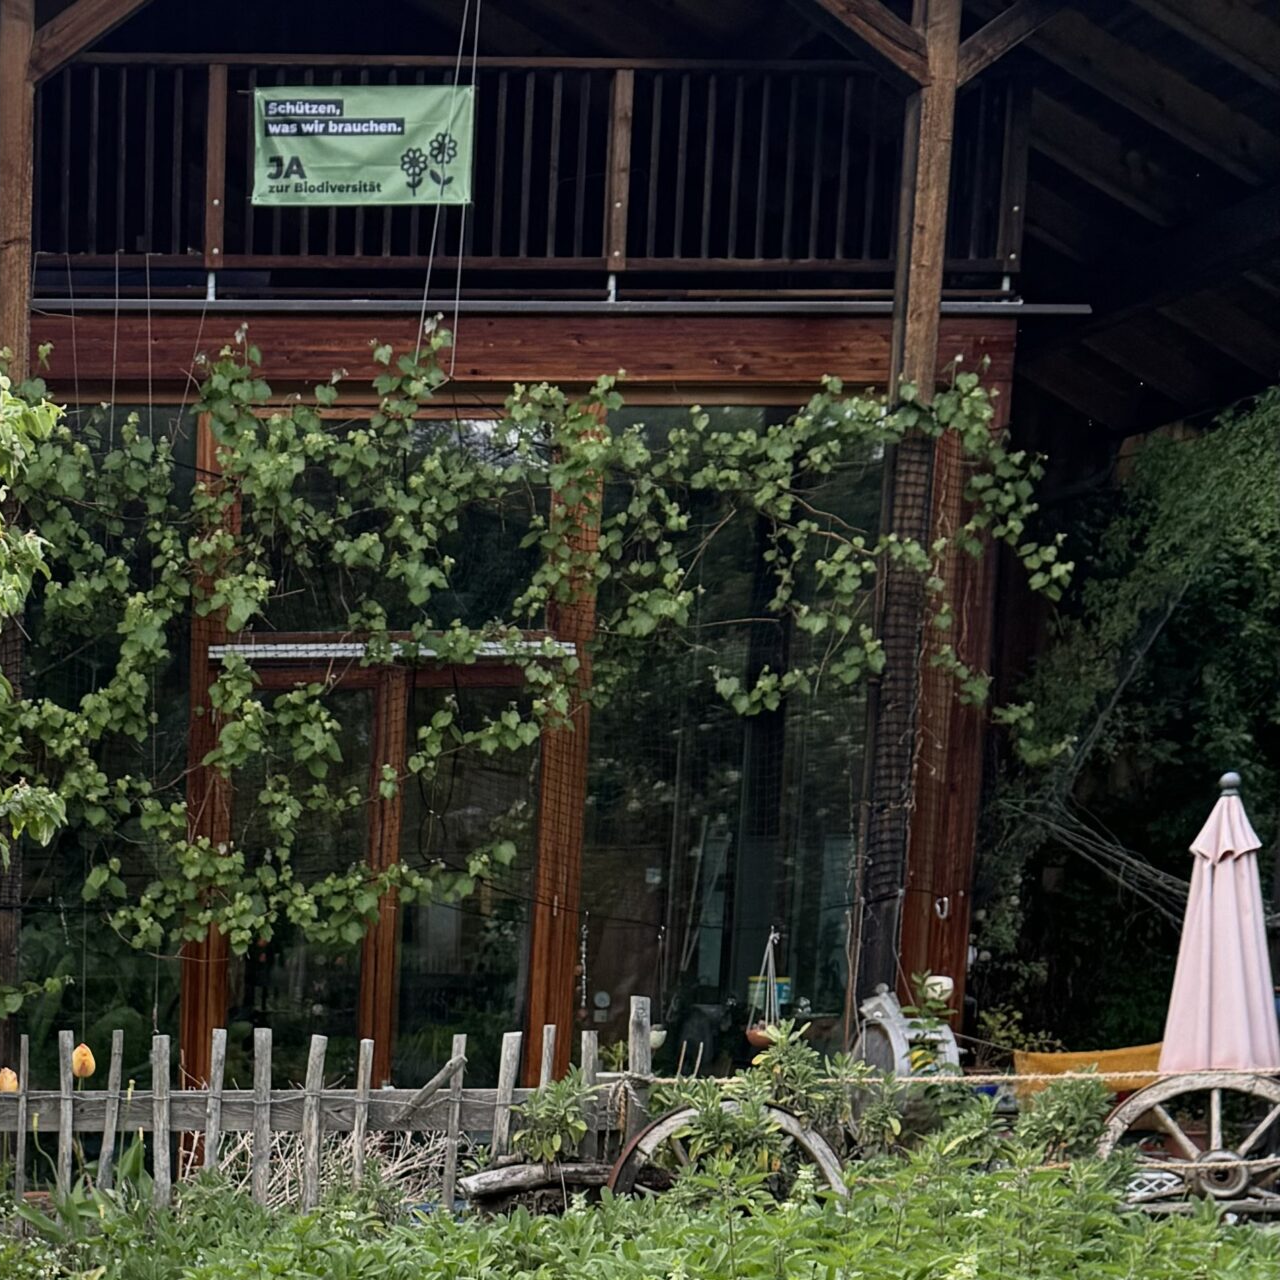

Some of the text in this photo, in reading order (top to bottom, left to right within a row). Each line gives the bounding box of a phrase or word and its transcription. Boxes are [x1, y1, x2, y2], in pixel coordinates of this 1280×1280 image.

[268, 101, 341, 115] Schützen,
[268, 120, 402, 133] was wir brauchen.
[267, 156, 307, 179] JA
[268, 181, 382, 193] zur Biodiversität
